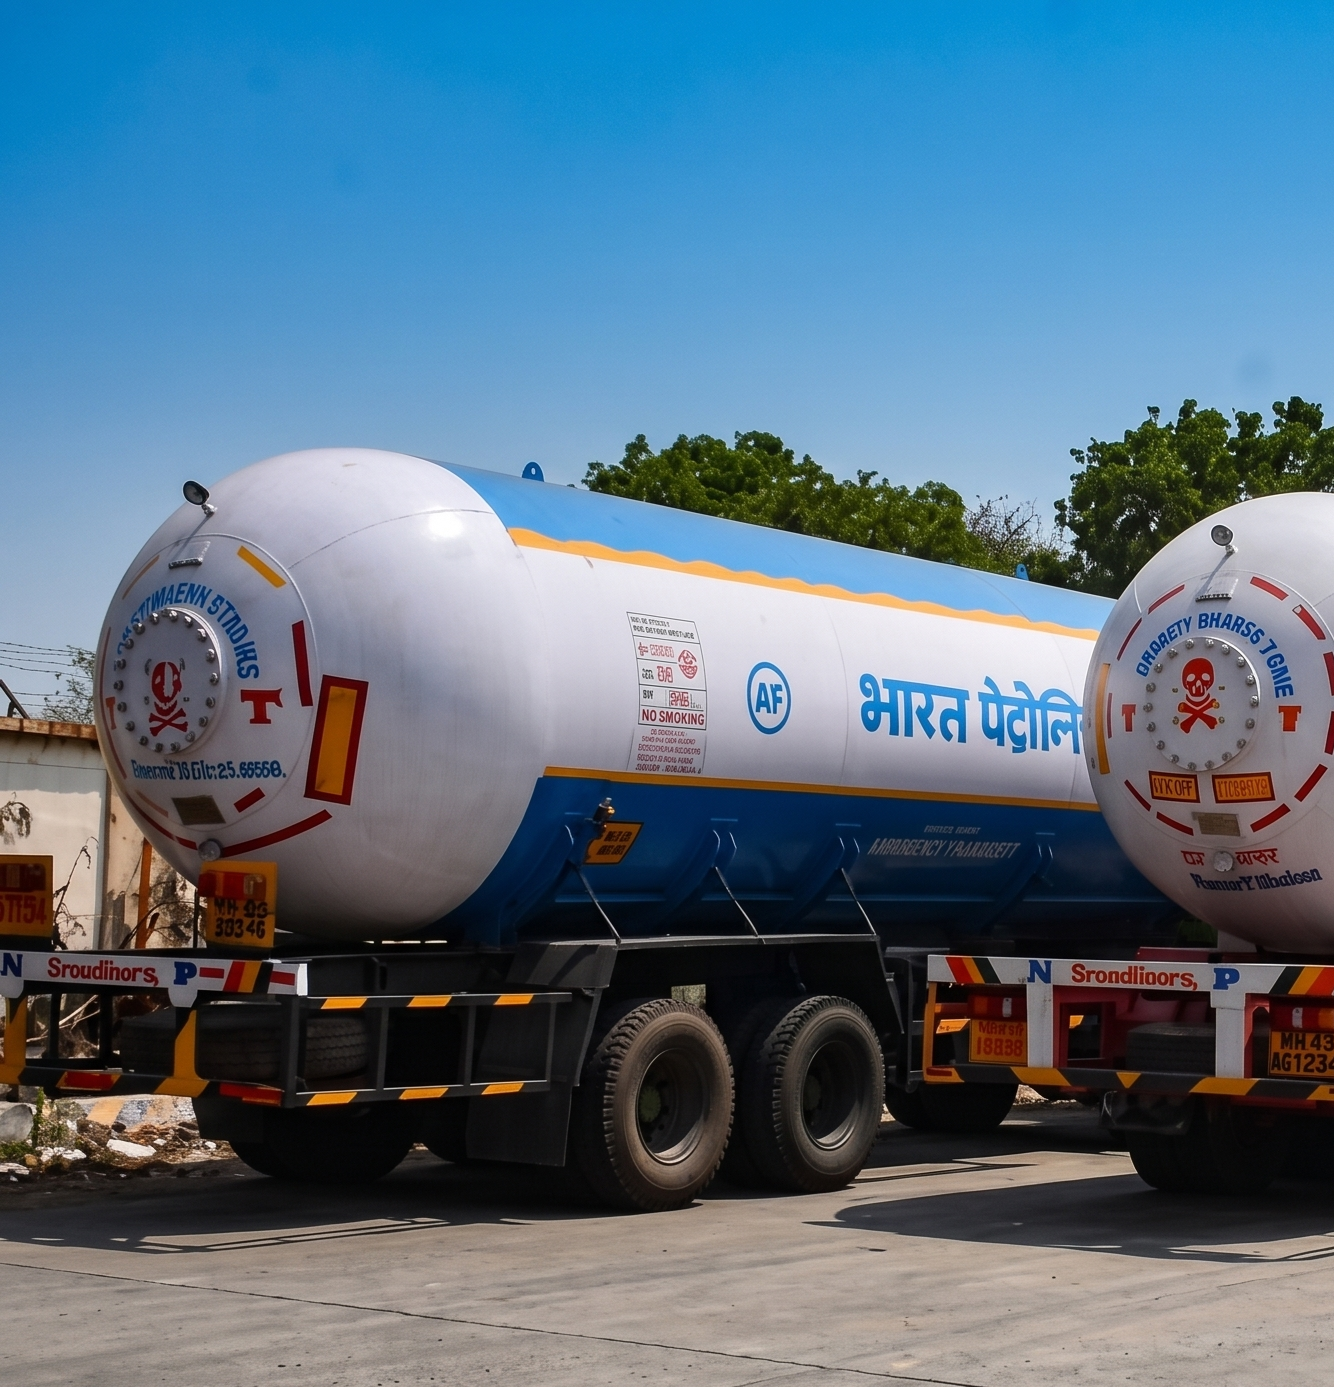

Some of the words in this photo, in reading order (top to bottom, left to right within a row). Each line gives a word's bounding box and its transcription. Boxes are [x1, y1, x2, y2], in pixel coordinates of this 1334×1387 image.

[642, 709, 656, 722] NO
[659, 710, 704, 726] SMOKING
[859, 673, 970, 744] भारत
[978, 675, 1083, 754] पेट्रोलि
[1, 954, 23, 977] N
[173, 961, 197, 985] P
[1027, 960, 1052, 983] N
[1213, 967, 1240, 990] P
[1280, 1032, 1306, 1050] MH
[1310, 1033, 1334, 1051] 43
